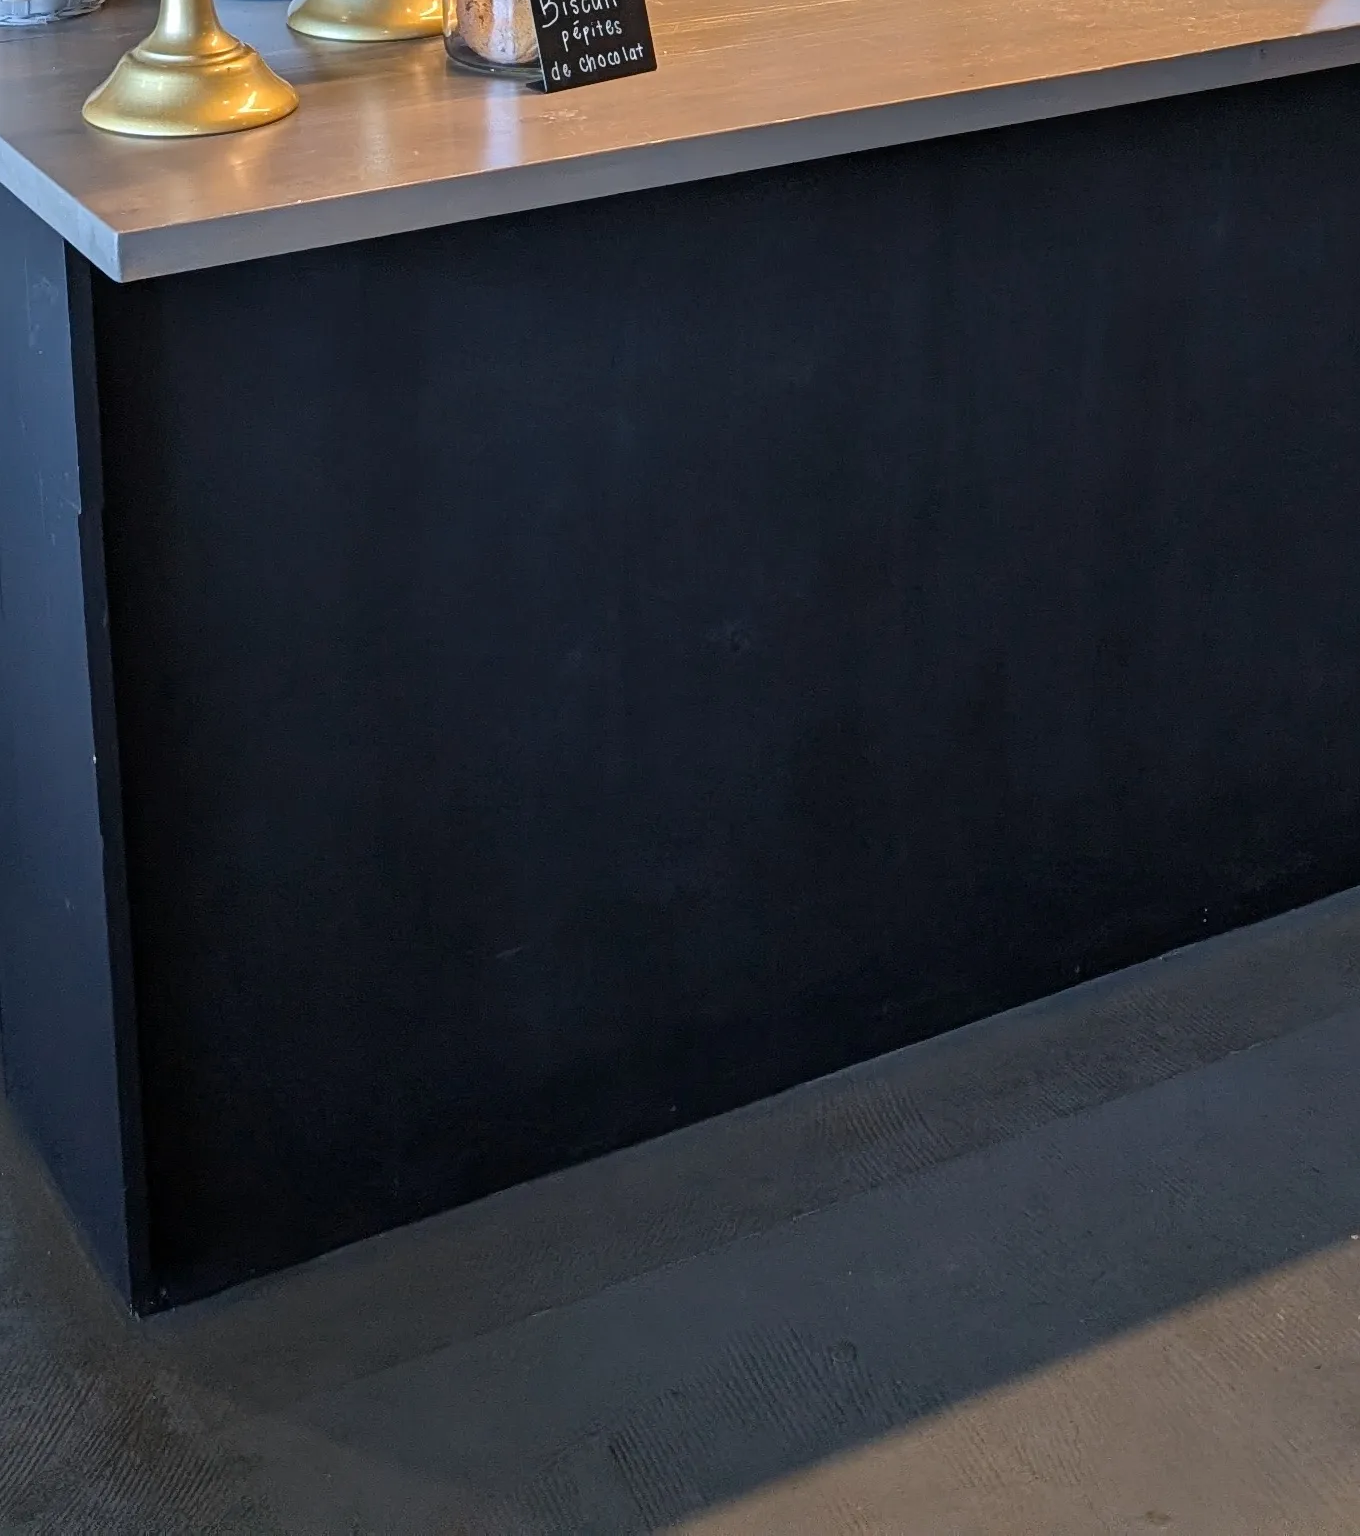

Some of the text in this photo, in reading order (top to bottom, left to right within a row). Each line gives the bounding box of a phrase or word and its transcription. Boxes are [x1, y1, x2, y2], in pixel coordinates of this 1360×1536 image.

[561, 19, 623, 53] pépites
[551, 42, 644, 81] de chocolat
